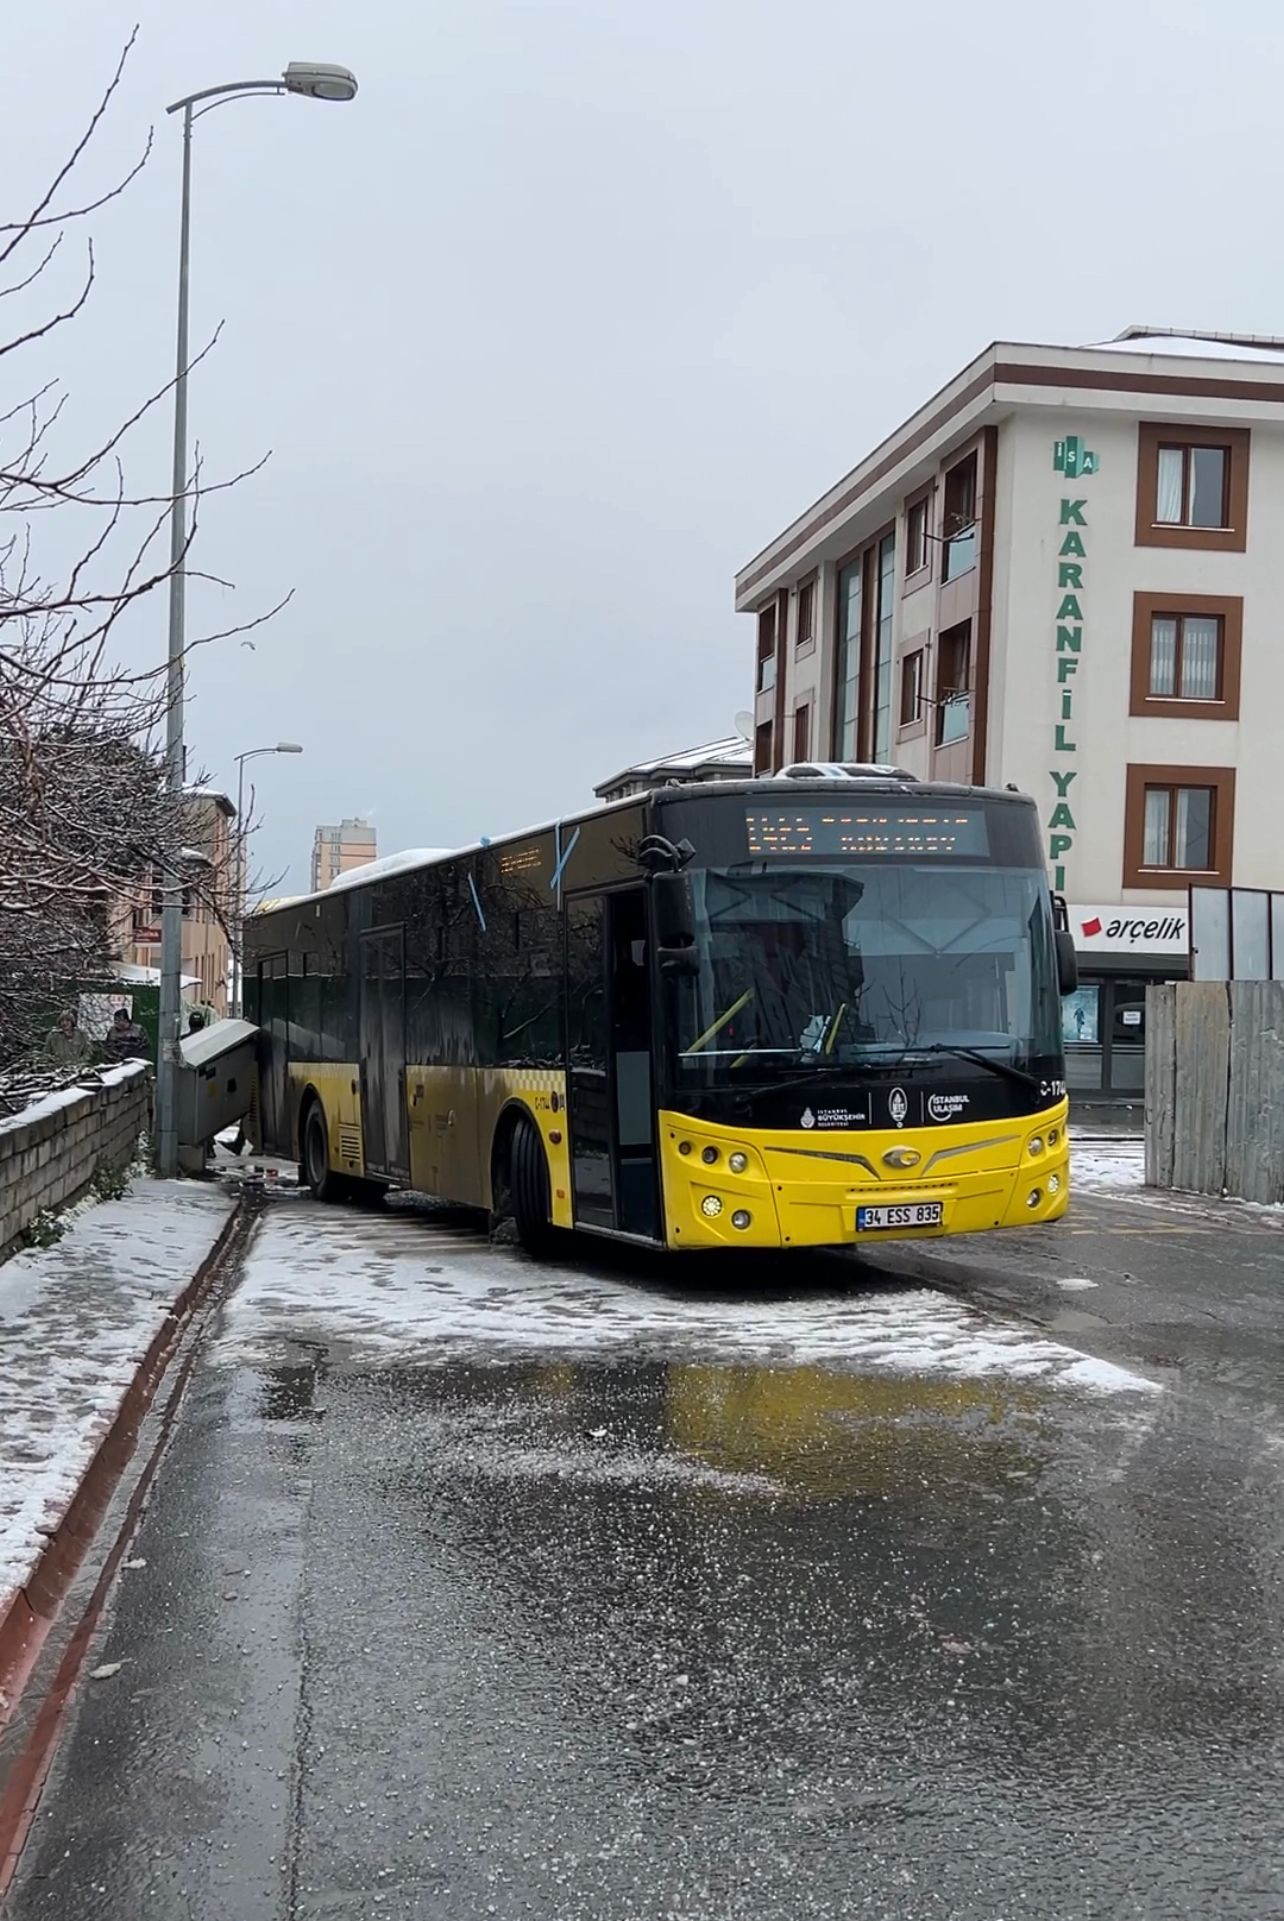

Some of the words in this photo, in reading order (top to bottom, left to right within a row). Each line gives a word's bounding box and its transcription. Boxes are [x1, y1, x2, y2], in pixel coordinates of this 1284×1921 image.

[1055, 498, 1088, 751] KARANFİL
[1048, 771, 1077, 891] YAPI
[1106, 917, 1185, 944] arçelik
[866, 1209, 881, 1225] 34
[887, 1207, 911, 1224] ESS
[916, 1205, 939, 1222] 835
